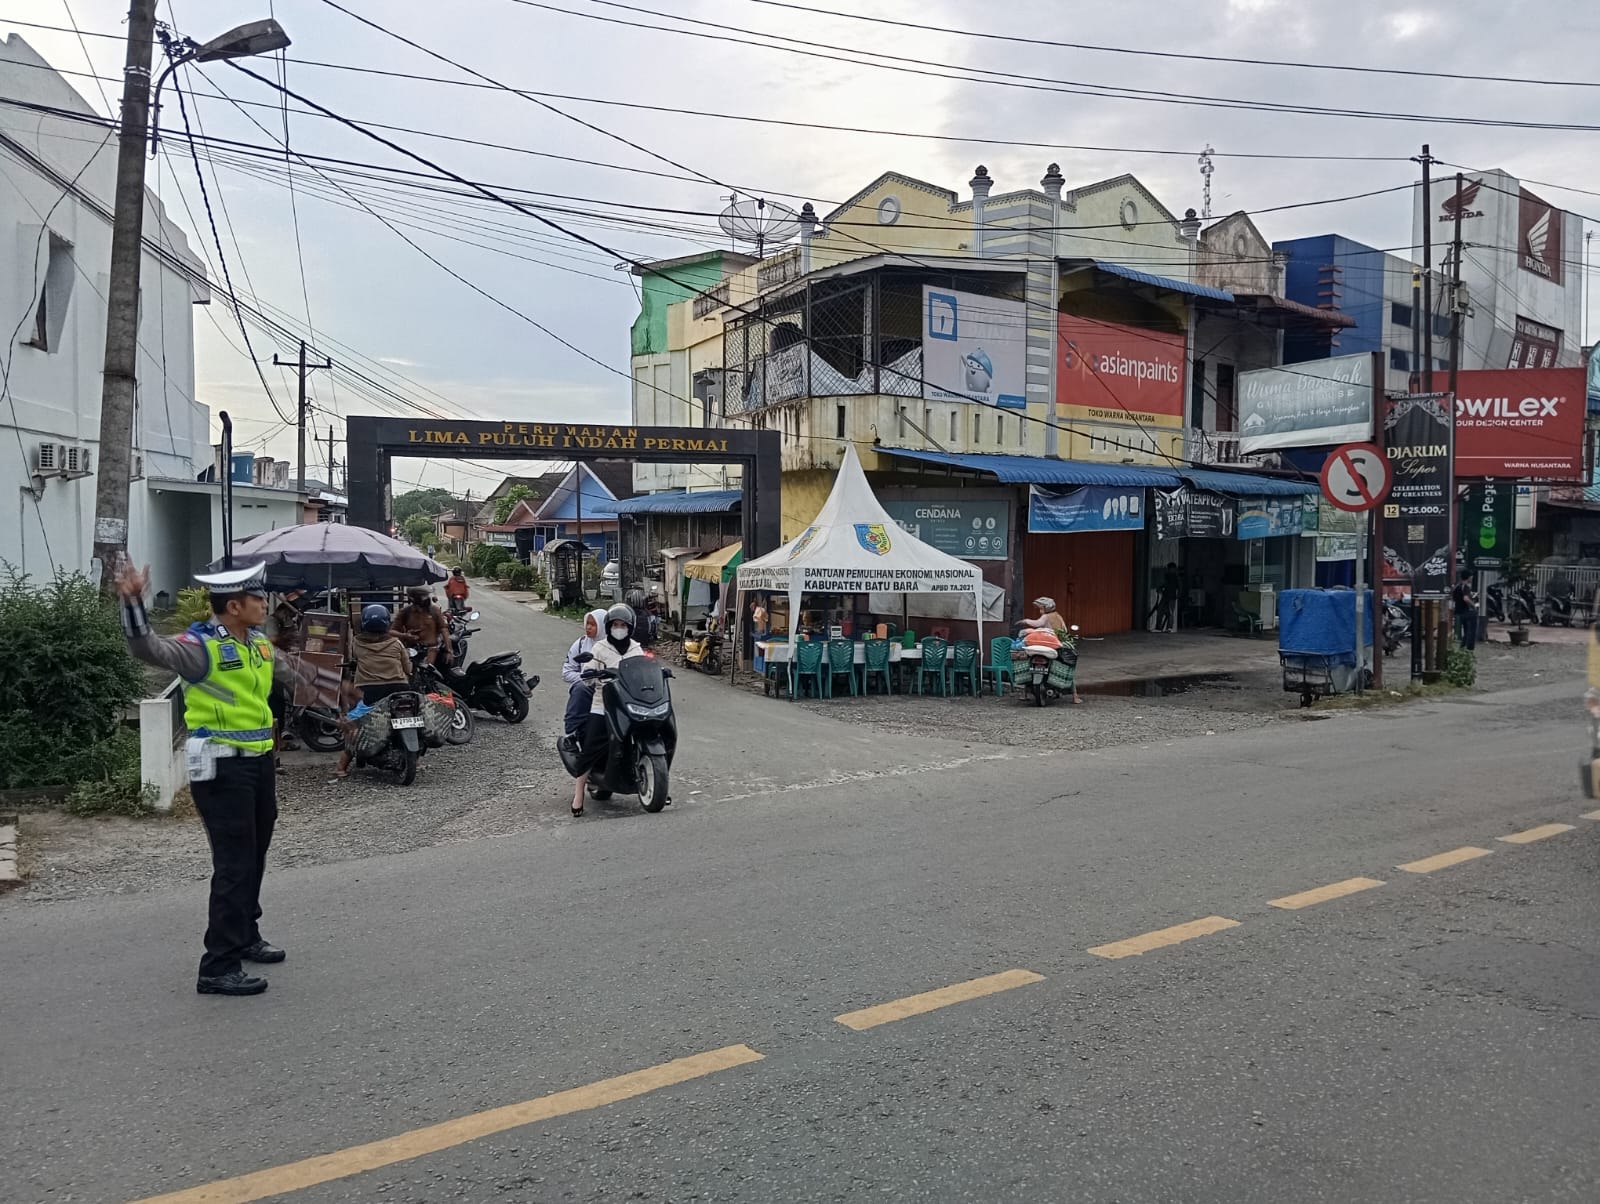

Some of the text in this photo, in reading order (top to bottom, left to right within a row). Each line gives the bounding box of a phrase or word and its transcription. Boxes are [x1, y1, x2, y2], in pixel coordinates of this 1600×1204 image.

[1525, 255, 1552, 277] HONDA
[1100, 350, 1178, 390] asianpaints
[1088, 408, 1104, 418] TOKO
[1104, 410, 1124, 420] WARNA
[1509, 419, 1544, 427] CENTER
[408, 430, 728, 452] LIMA PULUH INDAH PERMAI
[1386, 444, 1448, 460] DJARUM
[1395, 458, 1438, 480] Super
[1393, 484, 1442, 492] CELEBRATION
[1402, 490, 1443, 498] GREATNESS
[915, 508, 961, 519] CENDANA
[1386, 506, 1397, 515] 12
[804, 568, 975, 579] BANTUAN PEMULIHAN EKONOMI NASIONAL
[804, 580, 863, 591] KABUPATEN
[864, 581, 890, 591] BATU
[893, 581, 919, 591] BARA
